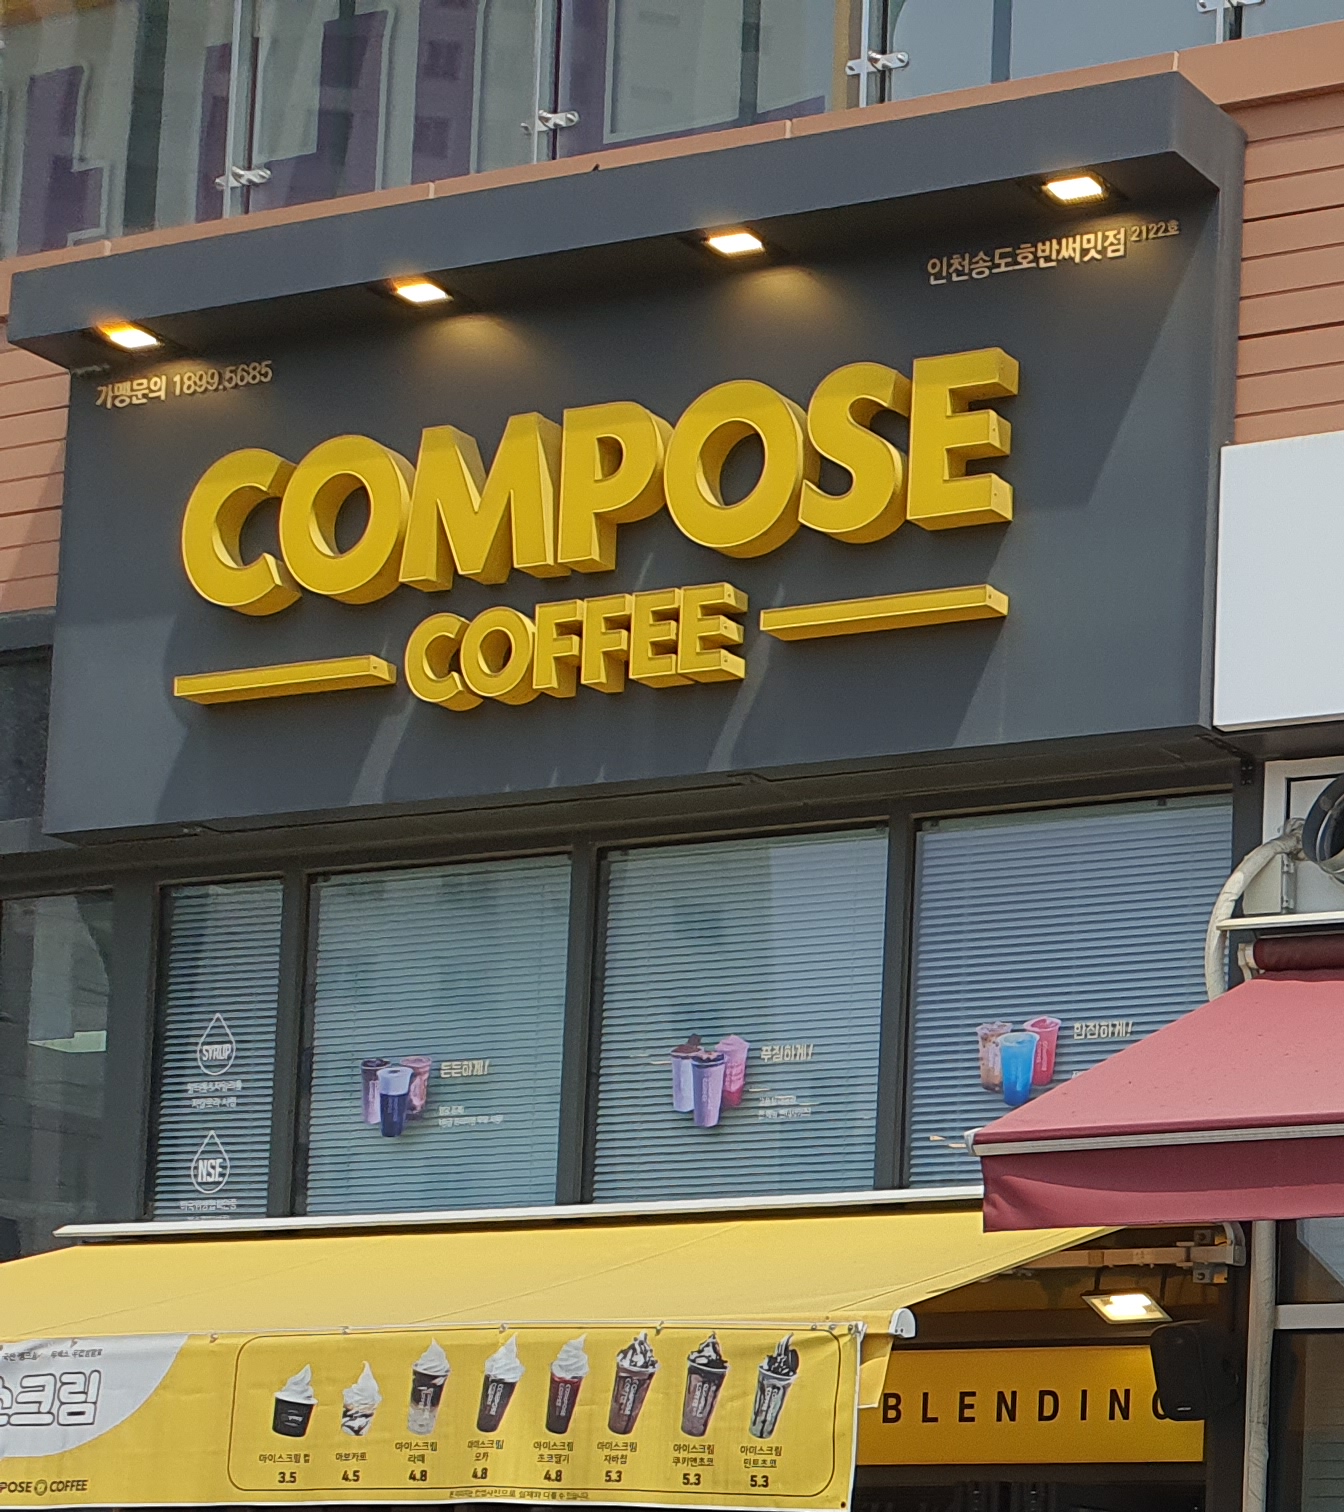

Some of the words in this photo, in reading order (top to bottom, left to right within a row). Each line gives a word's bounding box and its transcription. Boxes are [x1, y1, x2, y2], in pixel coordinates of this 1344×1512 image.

[1130, 219, 1180, 242] 2122호
[96, 374, 167, 409] 가맹문의
[173, 360, 273, 396] 1899.5685
[181, 346, 1019, 616] COMPOSE
[404, 580, 748, 712] COFFEE
[277, 1471, 297, 1484] 3.5
[341, 1469, 361, 1482] 4.5
[408, 1469, 428, 1482] 4.8
[471, 1467, 489, 1479] 4.8
[543, 1469, 563, 1482] 4.8
[604, 1470, 623, 1482] 5.3
[682, 1472, 702, 1485] 5.3
[50, 1479, 88, 1493] COFFEE
[750, 1475, 769, 1488] 5.3
